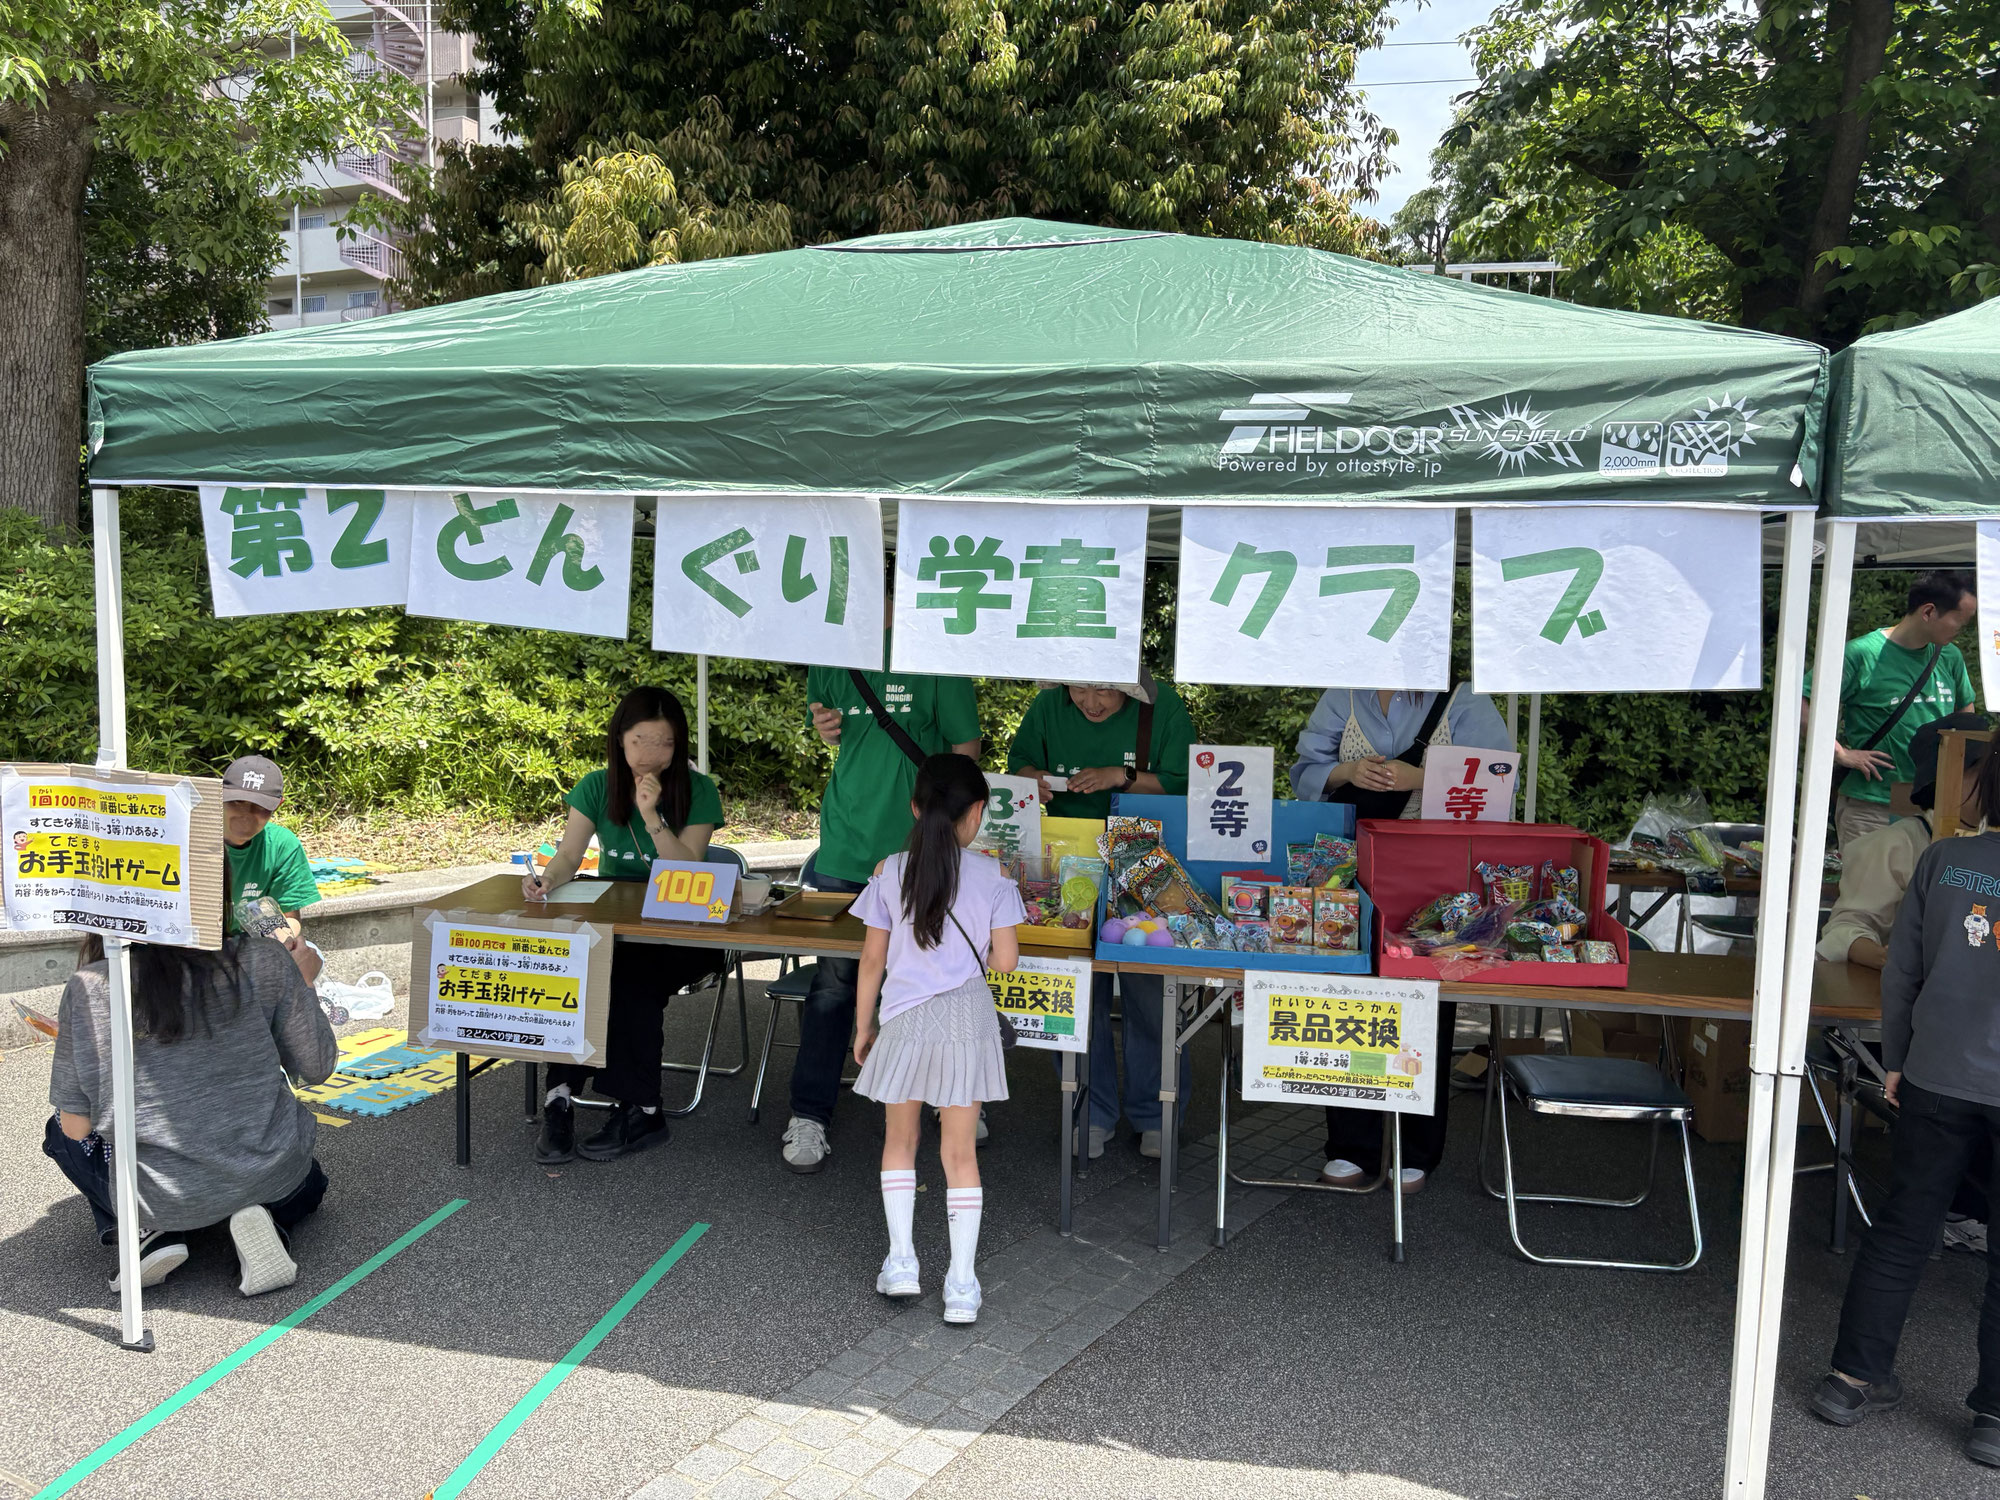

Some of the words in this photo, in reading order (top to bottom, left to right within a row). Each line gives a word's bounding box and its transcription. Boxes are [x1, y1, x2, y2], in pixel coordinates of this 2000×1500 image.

[1269, 425, 1443, 455] FIELDOOR
[1218, 456, 1297, 472] Powered
[1306, 456, 1328, 477] by
[1336, 456, 1442, 478] ottostyle.jp
[1604, 456, 1656, 468] 2,000mm
[19, 850, 181, 886] お手玉投げゲーム
[654, 869, 715, 906] 100
[439, 979, 578, 1009] お手玉投げゲーム
[1272, 997, 1398, 1015] けいひんこうかん
[1269, 1011, 1400, 1049] 景品交換
